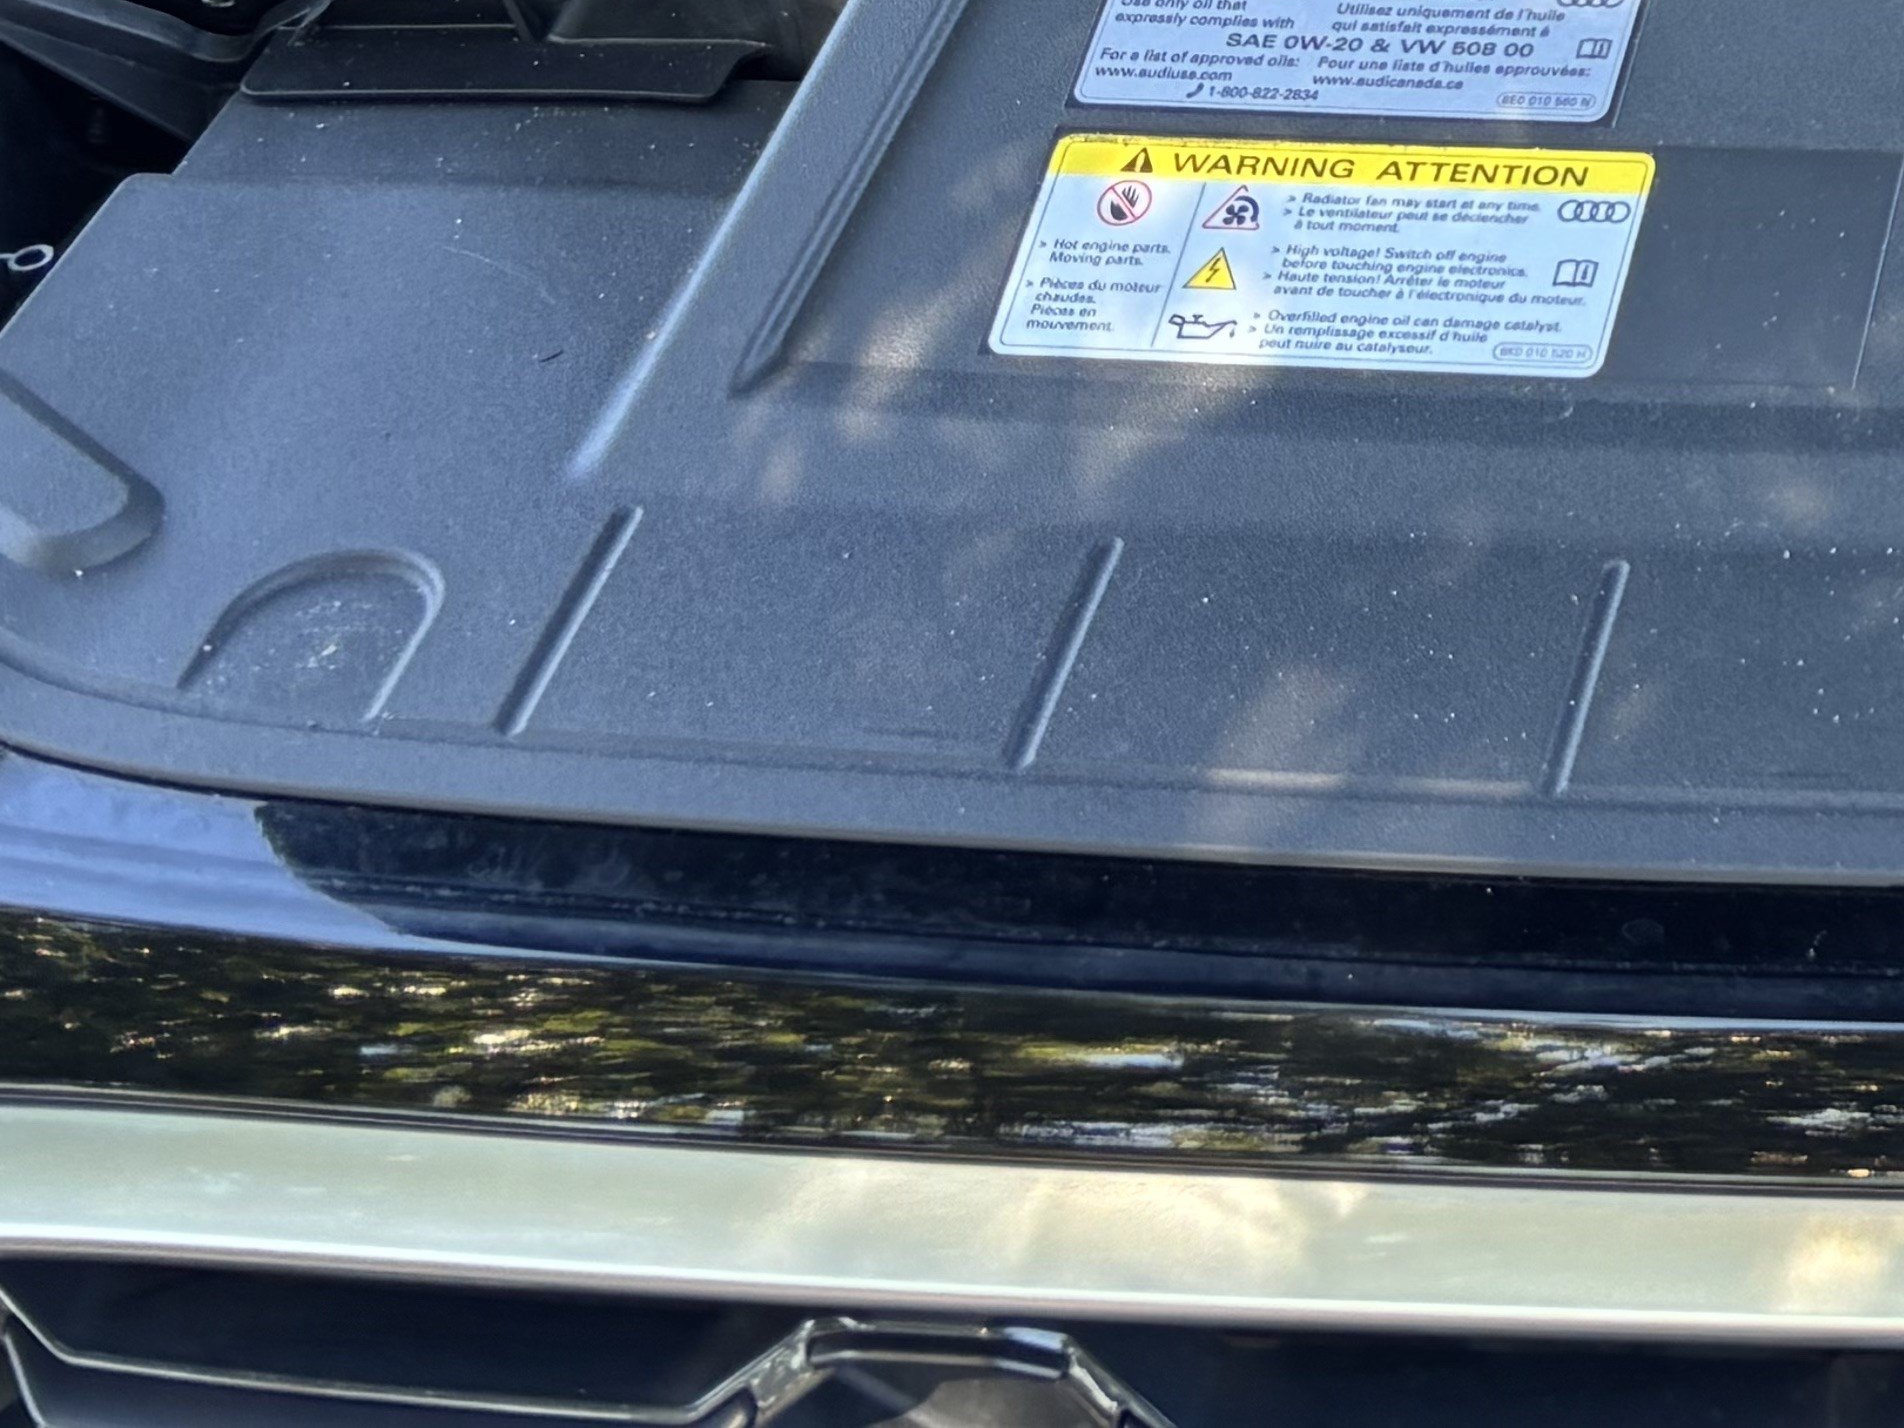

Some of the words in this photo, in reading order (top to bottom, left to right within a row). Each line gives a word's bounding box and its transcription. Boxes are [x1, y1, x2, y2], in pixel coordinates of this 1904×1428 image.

[1115, 13, 1186, 27] expressly
[1189, 14, 1258, 28] complies
[1262, 16, 1295, 28] with
[1337, 3, 1392, 16] Utilisez
[1397, 6, 1490, 21] uniquement
[1493, 8, 1513, 20] de
[1332, 21, 1356, 32] qui
[1361, 21, 1421, 34] satisfait
[1225, 33, 1278, 48] SAE
[1370, 41, 1390, 53] &
[1401, 39, 1446, 55] VW
[1452, 41, 1497, 56] 508
[1504, 43, 1535, 57] 00
[1100, 47, 1127, 60] For
[1130, 51, 1140, 61] a
[1143, 49, 1168, 62] list
[1171, 50, 1189, 63] of
[1189, 54, 1264, 68] approved
[1268, 55, 1299, 67] oils:
[1318, 56, 1354, 69] Pour
[1358, 61, 1387, 71] une
[1392, 58, 1424, 72] liste
[1095, 66, 1232, 81] www.audiusa.com
[1312, 75, 1464, 89] www.audicanada.ca
[1209, 85, 1319, 101] 1-800-822-2834
[1172, 151, 1356, 179] WARNING
[1376, 160, 1589, 187] ATTENTION
[1302, 192, 1361, 205] Radiator
[1365, 195, 1387, 206] fan
[1392, 198, 1421, 208] may
[1425, 199, 1457, 209] start
[1462, 200, 1475, 209] at
[1478, 202, 1503, 212] any
[1298, 207, 1315, 217] Le
[1319, 207, 1392, 219] ventilateur
[1396, 210, 1427, 221] peut
[1432, 212, 1448, 221] se
[1306, 220, 1335, 231] tout
[1053, 238, 1077, 249] Hot
[1082, 240, 1129, 253] engine
[1286, 244, 1319, 262] High
[1323, 246, 1380, 260] voltage!
[1384, 247, 1432, 260] Switch
[1436, 250, 1456, 260] off
[1458, 251, 1507, 264] engine
[1050, 252, 1101, 266] Moving
[1282, 257, 1327, 270] before
[1331, 259, 1393, 273] touching
[1397, 263, 1445, 275] engine
[1040, 276, 1084, 291] Pièces
[1088, 279, 1106, 291] du
[1110, 282, 1162, 294] moteur
[1278, 270, 1320, 283] Haute
[1323, 272, 1381, 285] tension!
[1384, 273, 1434, 287] Arrêter
[1437, 277, 1449, 287] le
[1454, 278, 1505, 290] moteur
[1273, 285, 1313, 295] avant
[1316, 286, 1335, 297] de
[1338, 287, 1392, 298] toucher
[1508, 293, 1527, 304] du
[1079, 307, 1096, 317] en
[1268, 309, 1337, 323] Overfilled
[1340, 314, 1388, 326] engine
[1392, 316, 1410, 326] oil
[1413, 318, 1439, 327] can
[1443, 317, 1501, 331] damage
[1264, 323, 1285, 335] Un
[1288, 327, 1374, 340] remplissage
[1378, 328, 1437, 341] excessif
[1258, 339, 1292, 349] peut
[1294, 340, 1332, 350] nuire
[1335, 343, 1353, 352] au
